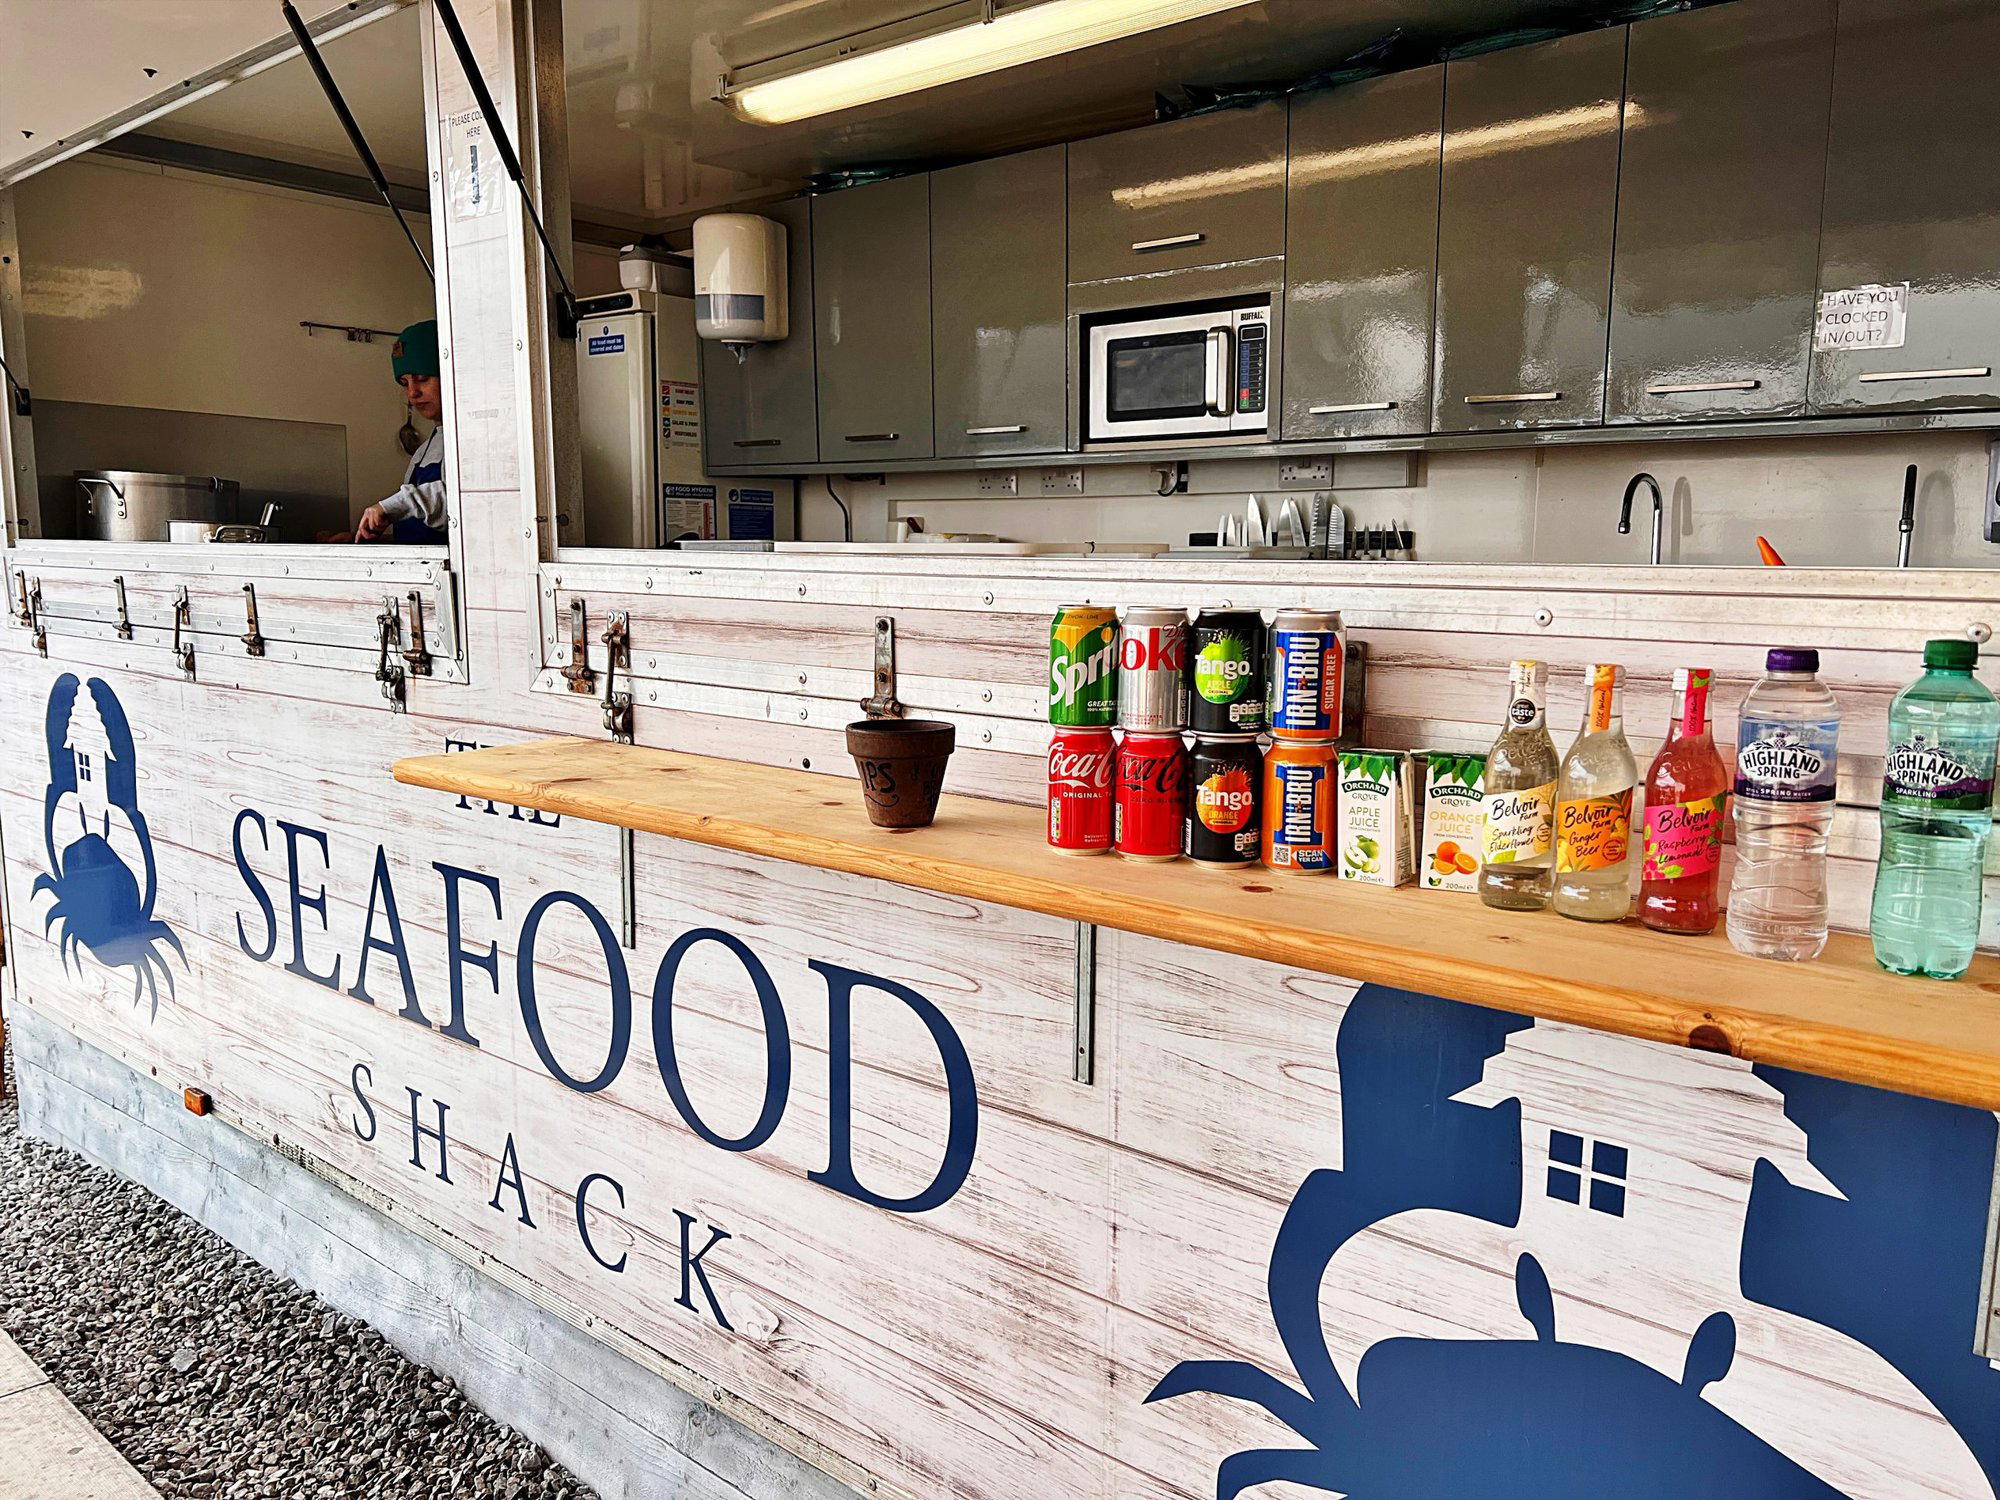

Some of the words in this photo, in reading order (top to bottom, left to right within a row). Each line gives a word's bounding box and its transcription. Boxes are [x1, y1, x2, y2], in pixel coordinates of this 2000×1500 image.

[451, 112, 470, 127] PLEASE
[466, 126, 480, 138] HERE
[1827, 293, 1864, 306] HAVE
[1869, 290, 1898, 304] YOU
[1825, 310, 1888, 325] CLOCKED
[1823, 329, 1882, 344] IN/OUT?
[1326, 654, 1337, 676] FREE
[1324, 679, 1335, 709] SUGAR
[1511, 708, 1535, 717] taste
[1743, 751, 1820, 774] HIGHLAND
[1887, 754, 1964, 781] HIGHLAND
[1757, 766, 1800, 779] SPRING
[1896, 770, 1940, 785] SPRING
[1344, 782, 1387, 794] ORCHARD
[1432, 787, 1481, 800] ORCHARD
[1760, 788, 1792, 796] SPRING
[1896, 787, 1937, 799] SPARKLING
[1351, 792, 1379, 801] GROVE
[1440, 798, 1471, 807] GROVE
[1348, 806, 1380, 817] APPLE
[1491, 797, 1540, 821] Belvoir
[1563, 804, 1613, 828] Belvoir
[1349, 816, 1380, 828] JUICE
[1429, 810, 1481, 824] ORANGE
[1657, 807, 1712, 833] Belvoir
[1437, 823, 1472, 834] JUICE
[1492, 825, 1535, 841] Sparkling
[1490, 837, 1535, 852] Elderflower
[1569, 831, 1602, 846] Ginger
[1657, 835, 1708, 853] Raspberry
[1298, 849, 1323, 857] SCAN
[1575, 845, 1600, 858] Beer
[1658, 845, 1704, 864] Lemonade
[231, 807, 979, 1214] SEAFOOD
[351, 1062, 734, 1331] SHACK
